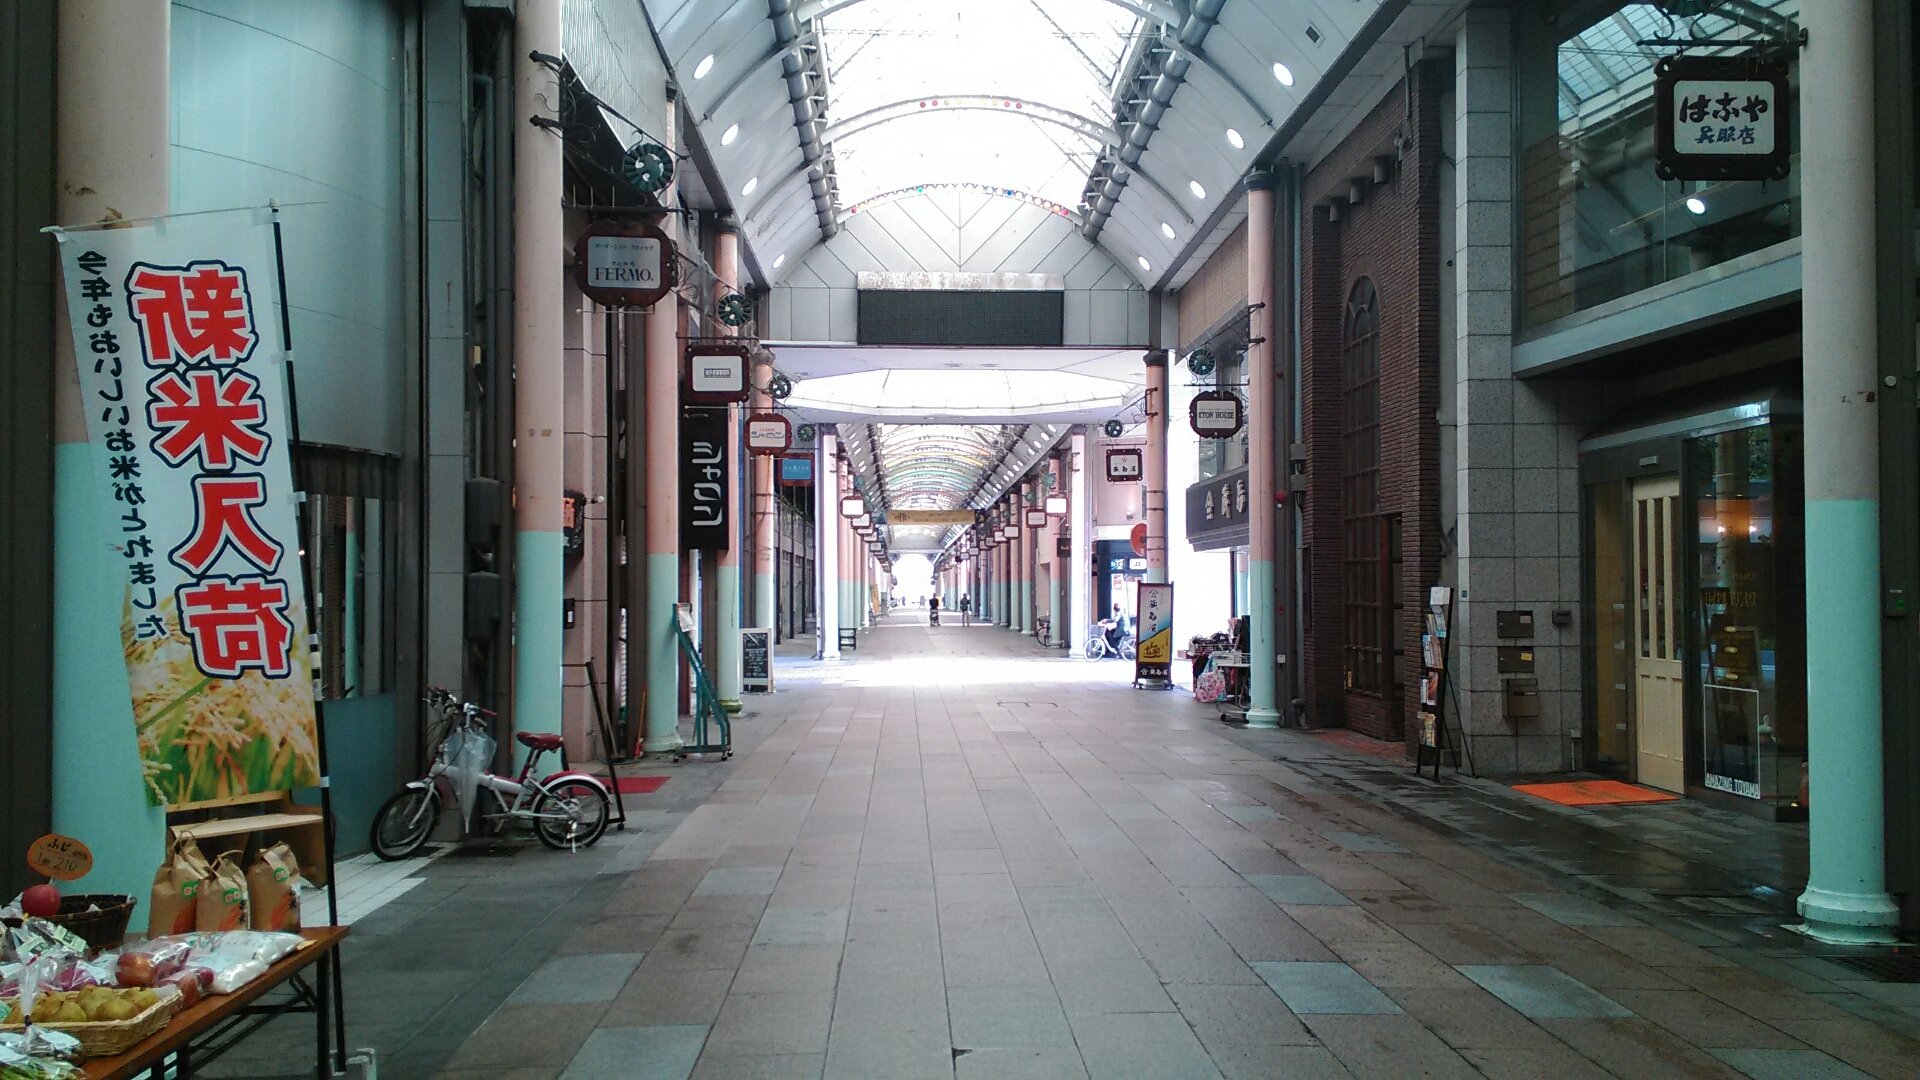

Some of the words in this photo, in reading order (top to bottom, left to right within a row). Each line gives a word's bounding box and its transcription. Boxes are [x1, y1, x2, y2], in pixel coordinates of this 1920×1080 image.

[1694, 126, 1755, 145] 呉服店
[595, 267, 651, 281] FERMO
[692, 441, 723, 526] シャロン
[1706, 773, 1733, 791] AMAZING
[1733, 779, 1759, 798] TOYAMA
